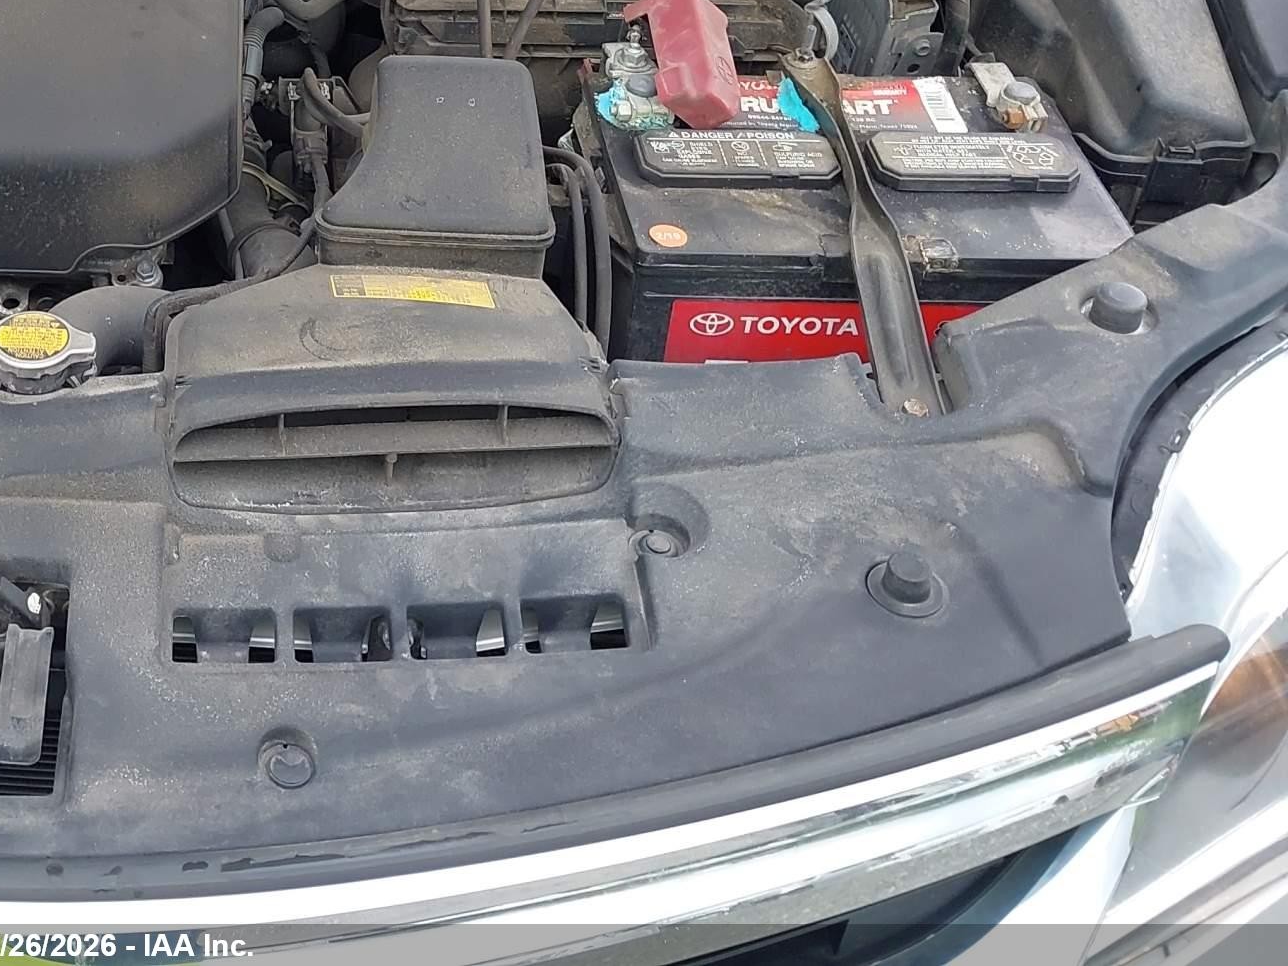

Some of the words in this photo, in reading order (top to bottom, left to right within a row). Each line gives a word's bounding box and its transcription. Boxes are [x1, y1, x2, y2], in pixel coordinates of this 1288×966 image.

[680, 131, 734, 139] DANGER
[746, 132, 795, 140] POISON
[740, 315, 859, 337] TOYOTA
